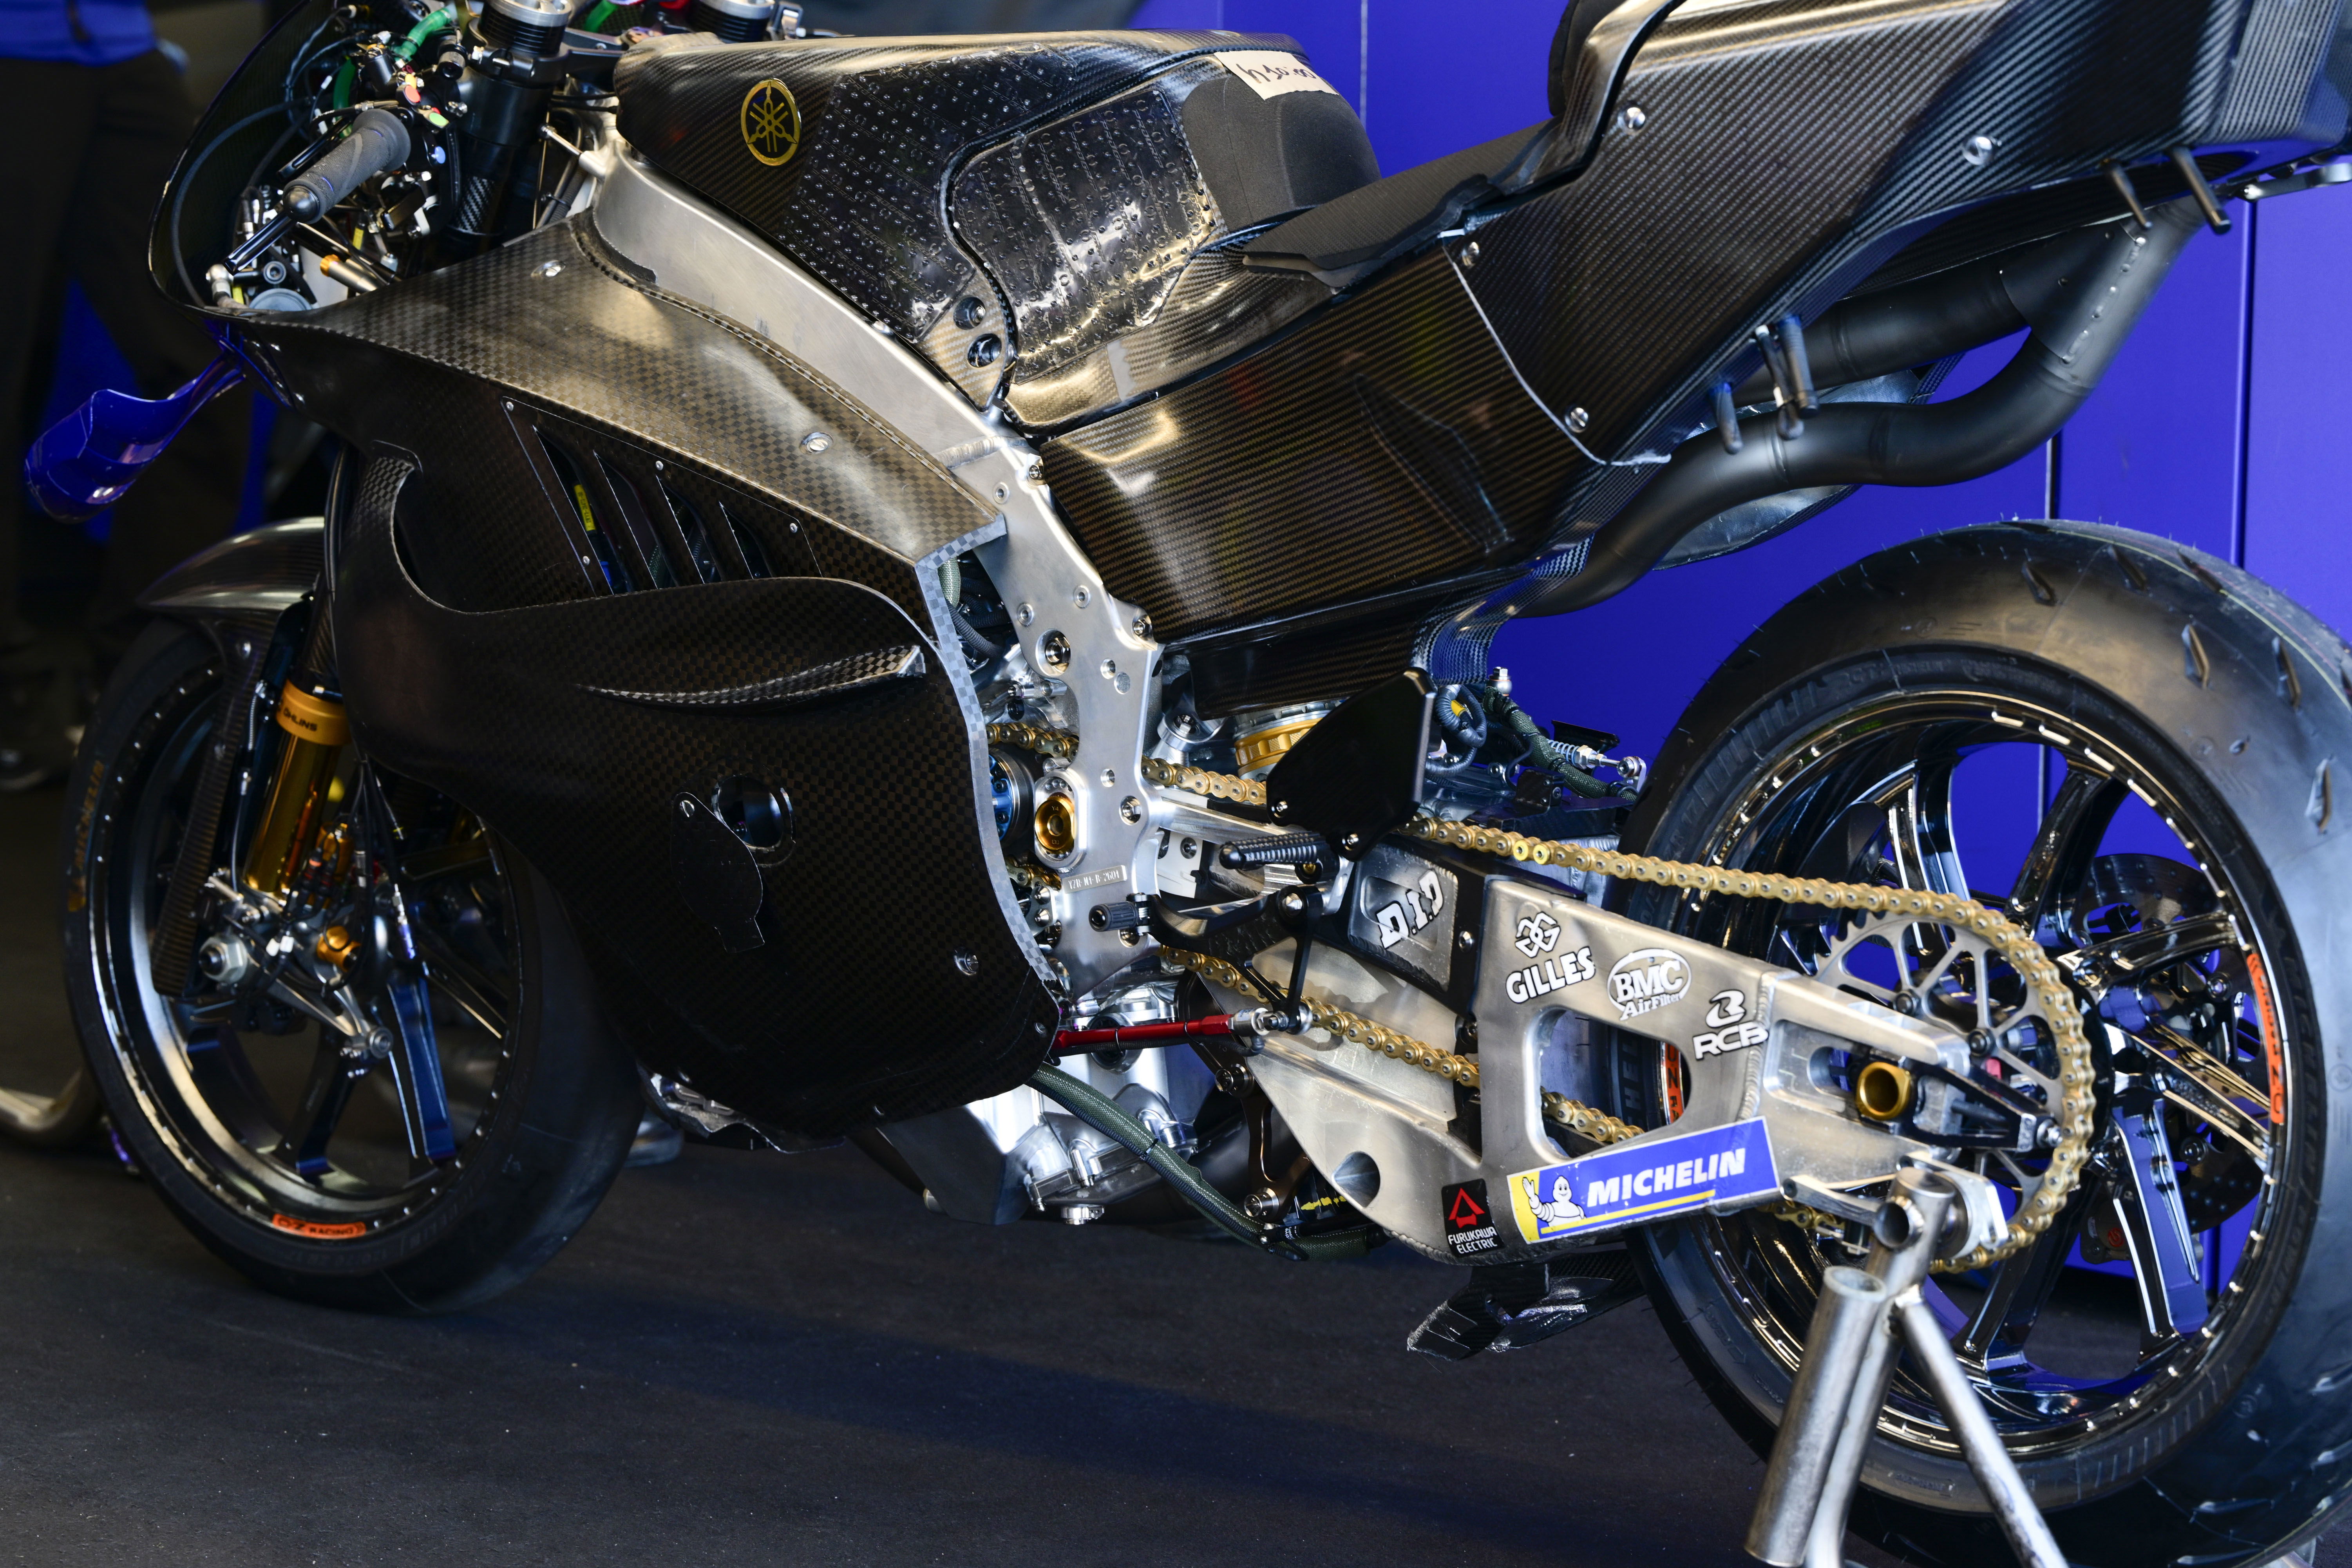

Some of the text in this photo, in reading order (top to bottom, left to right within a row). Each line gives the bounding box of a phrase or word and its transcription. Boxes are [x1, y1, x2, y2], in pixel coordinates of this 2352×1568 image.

[1375, 868, 1444, 949] D.I.D
[1505, 946, 1596, 1004] GILLES
[1613, 959, 1684, 1004] BMC
[1693, 1021, 1769, 1061] RCB
[1587, 1148, 1746, 1207] MICHELIN
[1447, 1227, 1498, 1246] FURUKAWA
[1456, 1237, 1496, 1255] ELECTRIC
